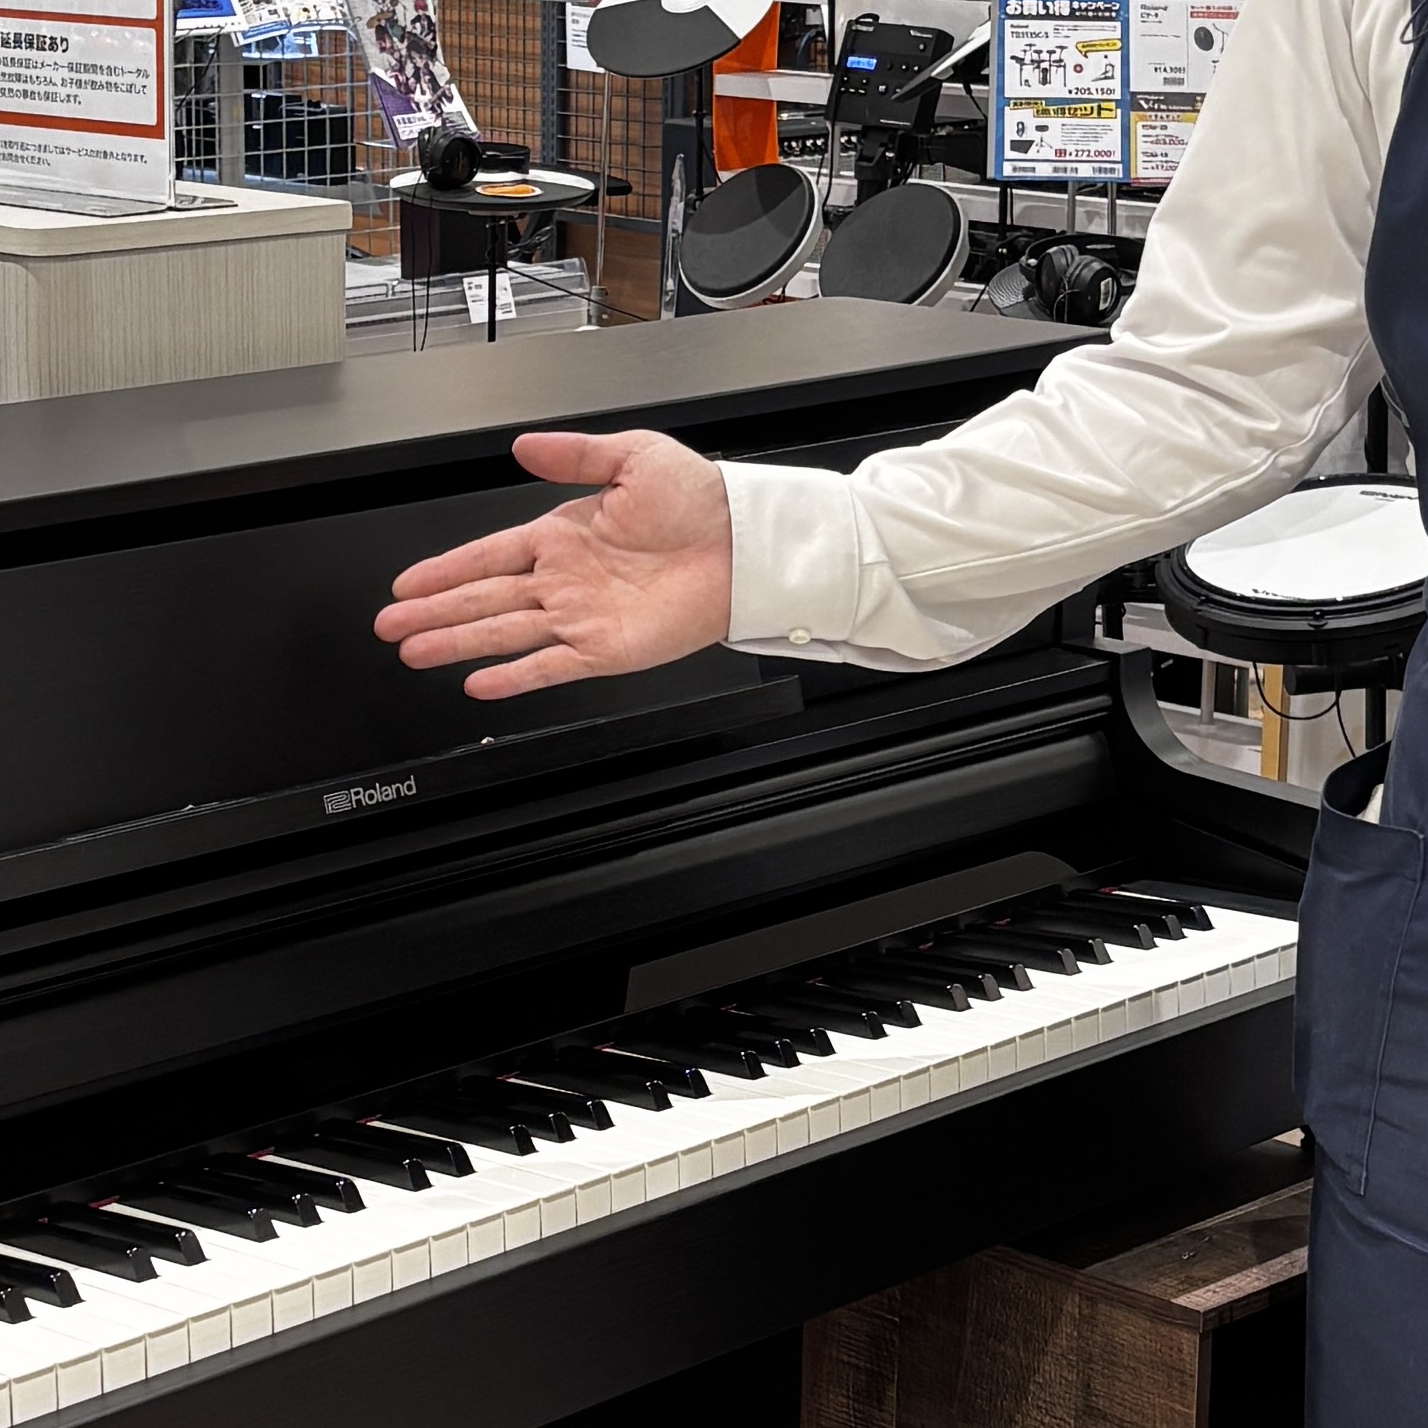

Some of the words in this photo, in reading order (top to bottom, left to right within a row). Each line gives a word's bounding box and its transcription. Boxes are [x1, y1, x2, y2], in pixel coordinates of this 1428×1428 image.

[1005, 0, 1071, 17] お買い得
[350, 774, 418, 809] Roland
